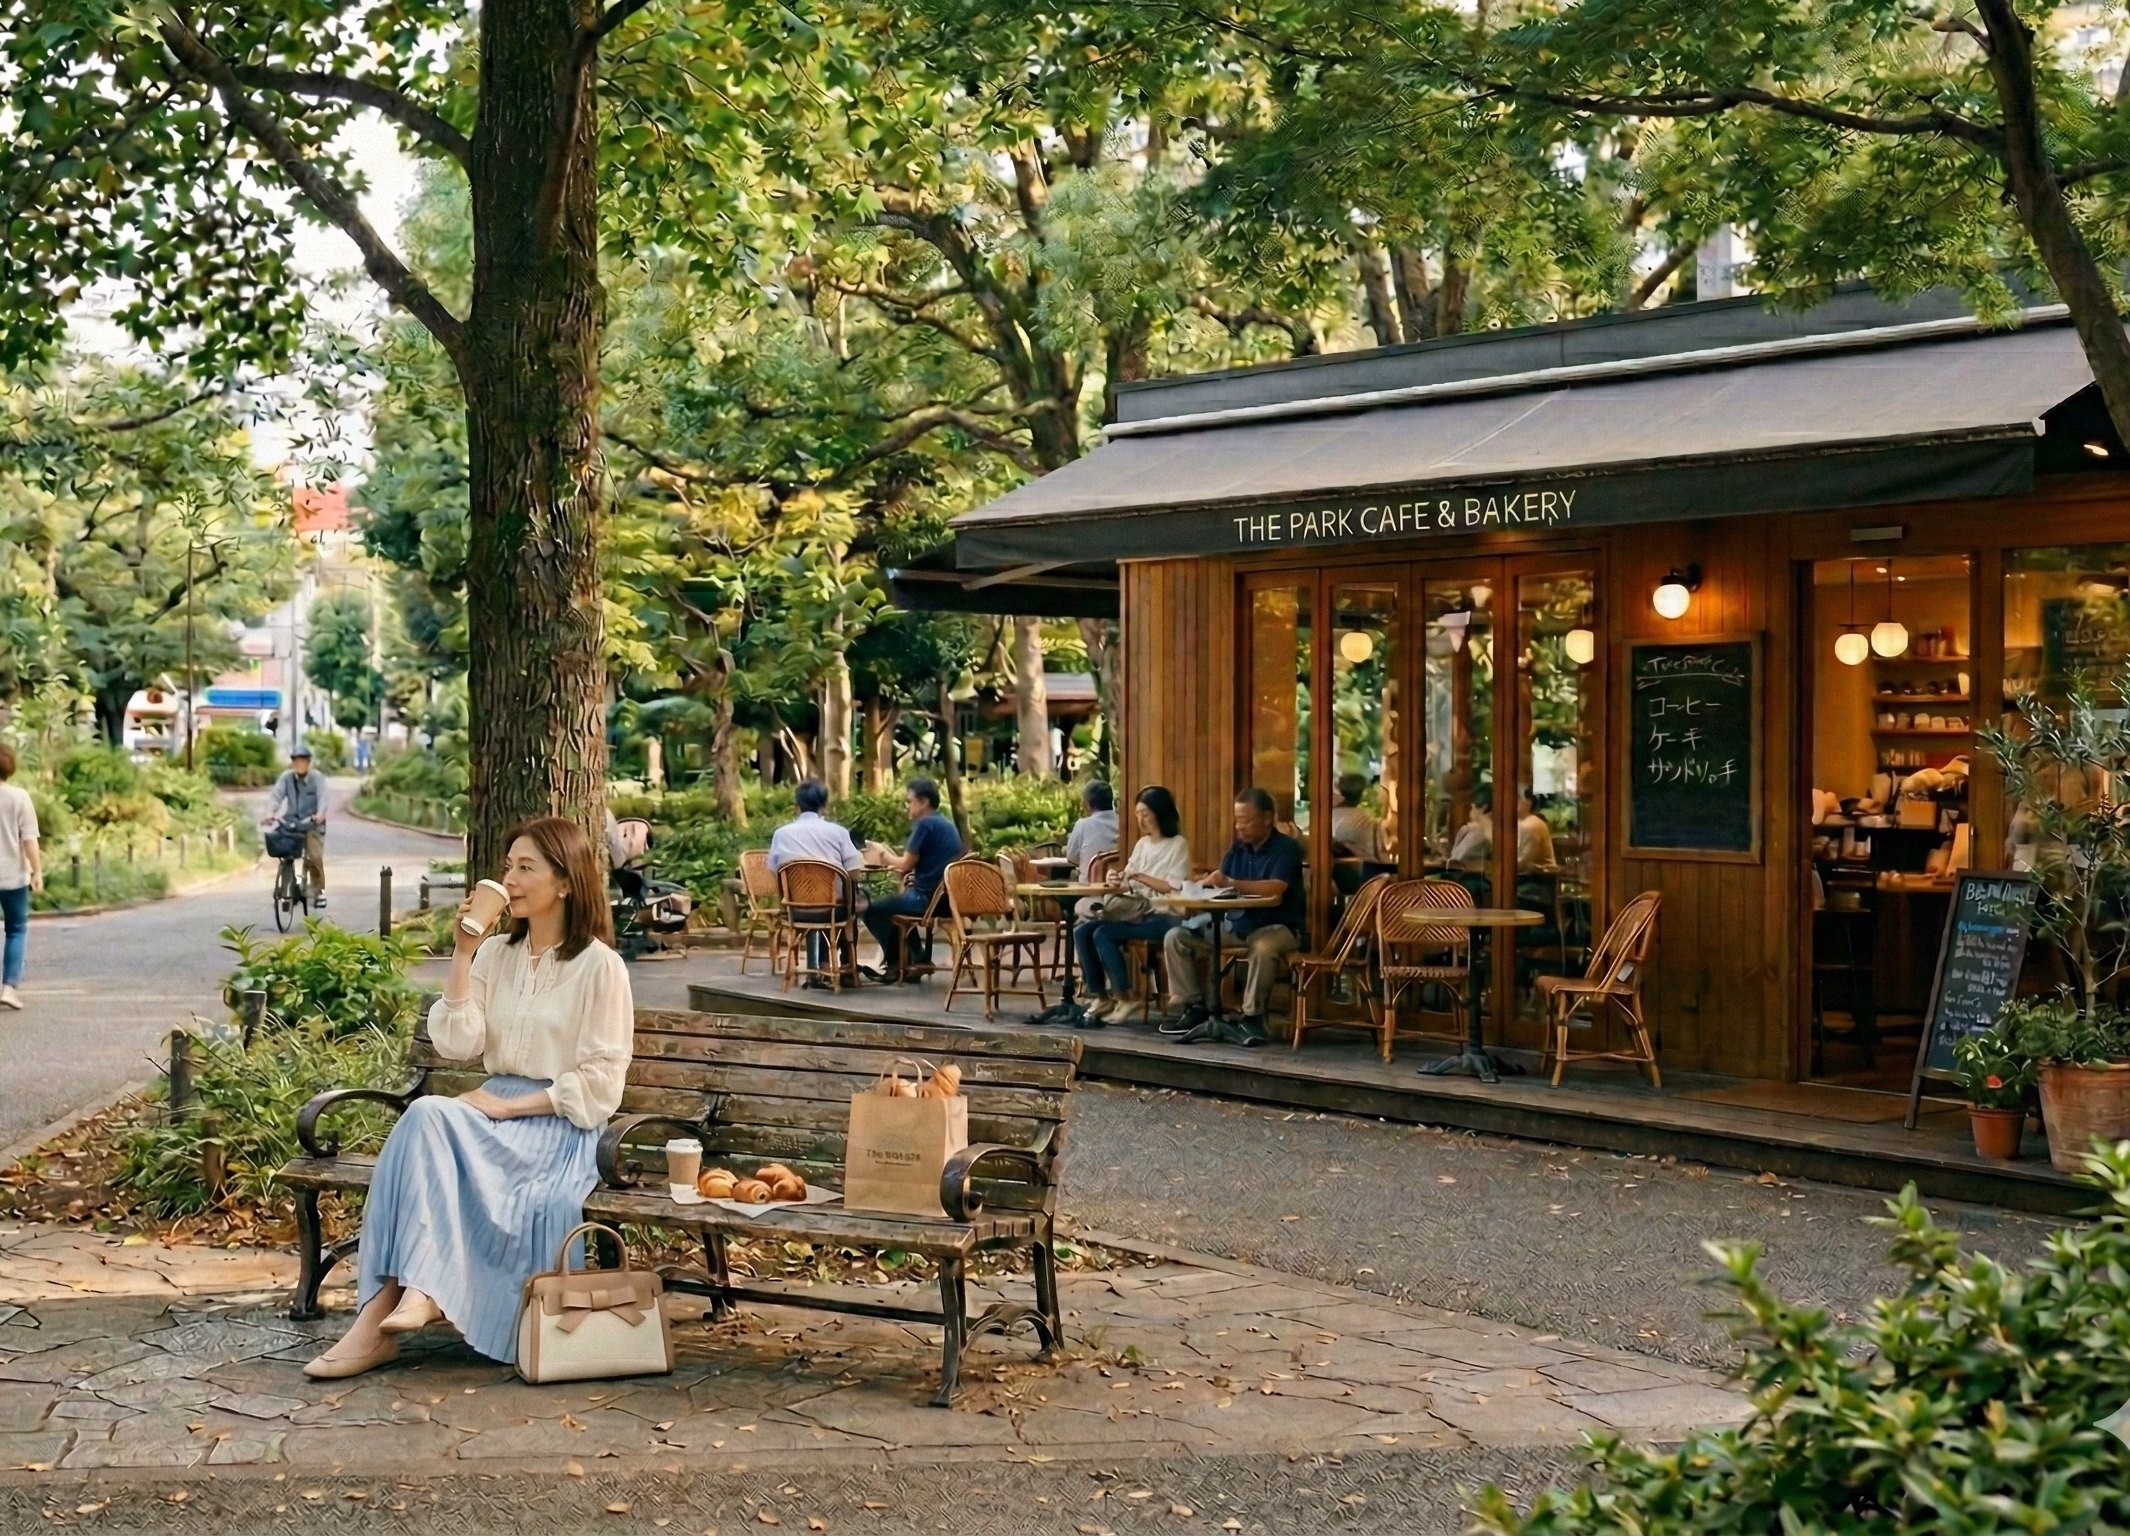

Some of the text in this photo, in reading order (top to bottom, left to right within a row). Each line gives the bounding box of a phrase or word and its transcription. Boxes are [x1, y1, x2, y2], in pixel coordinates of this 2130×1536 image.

[1233, 490, 1577, 544] THE PARK CAFE & BAKERY
[1648, 723, 1703, 752] ケーキ
